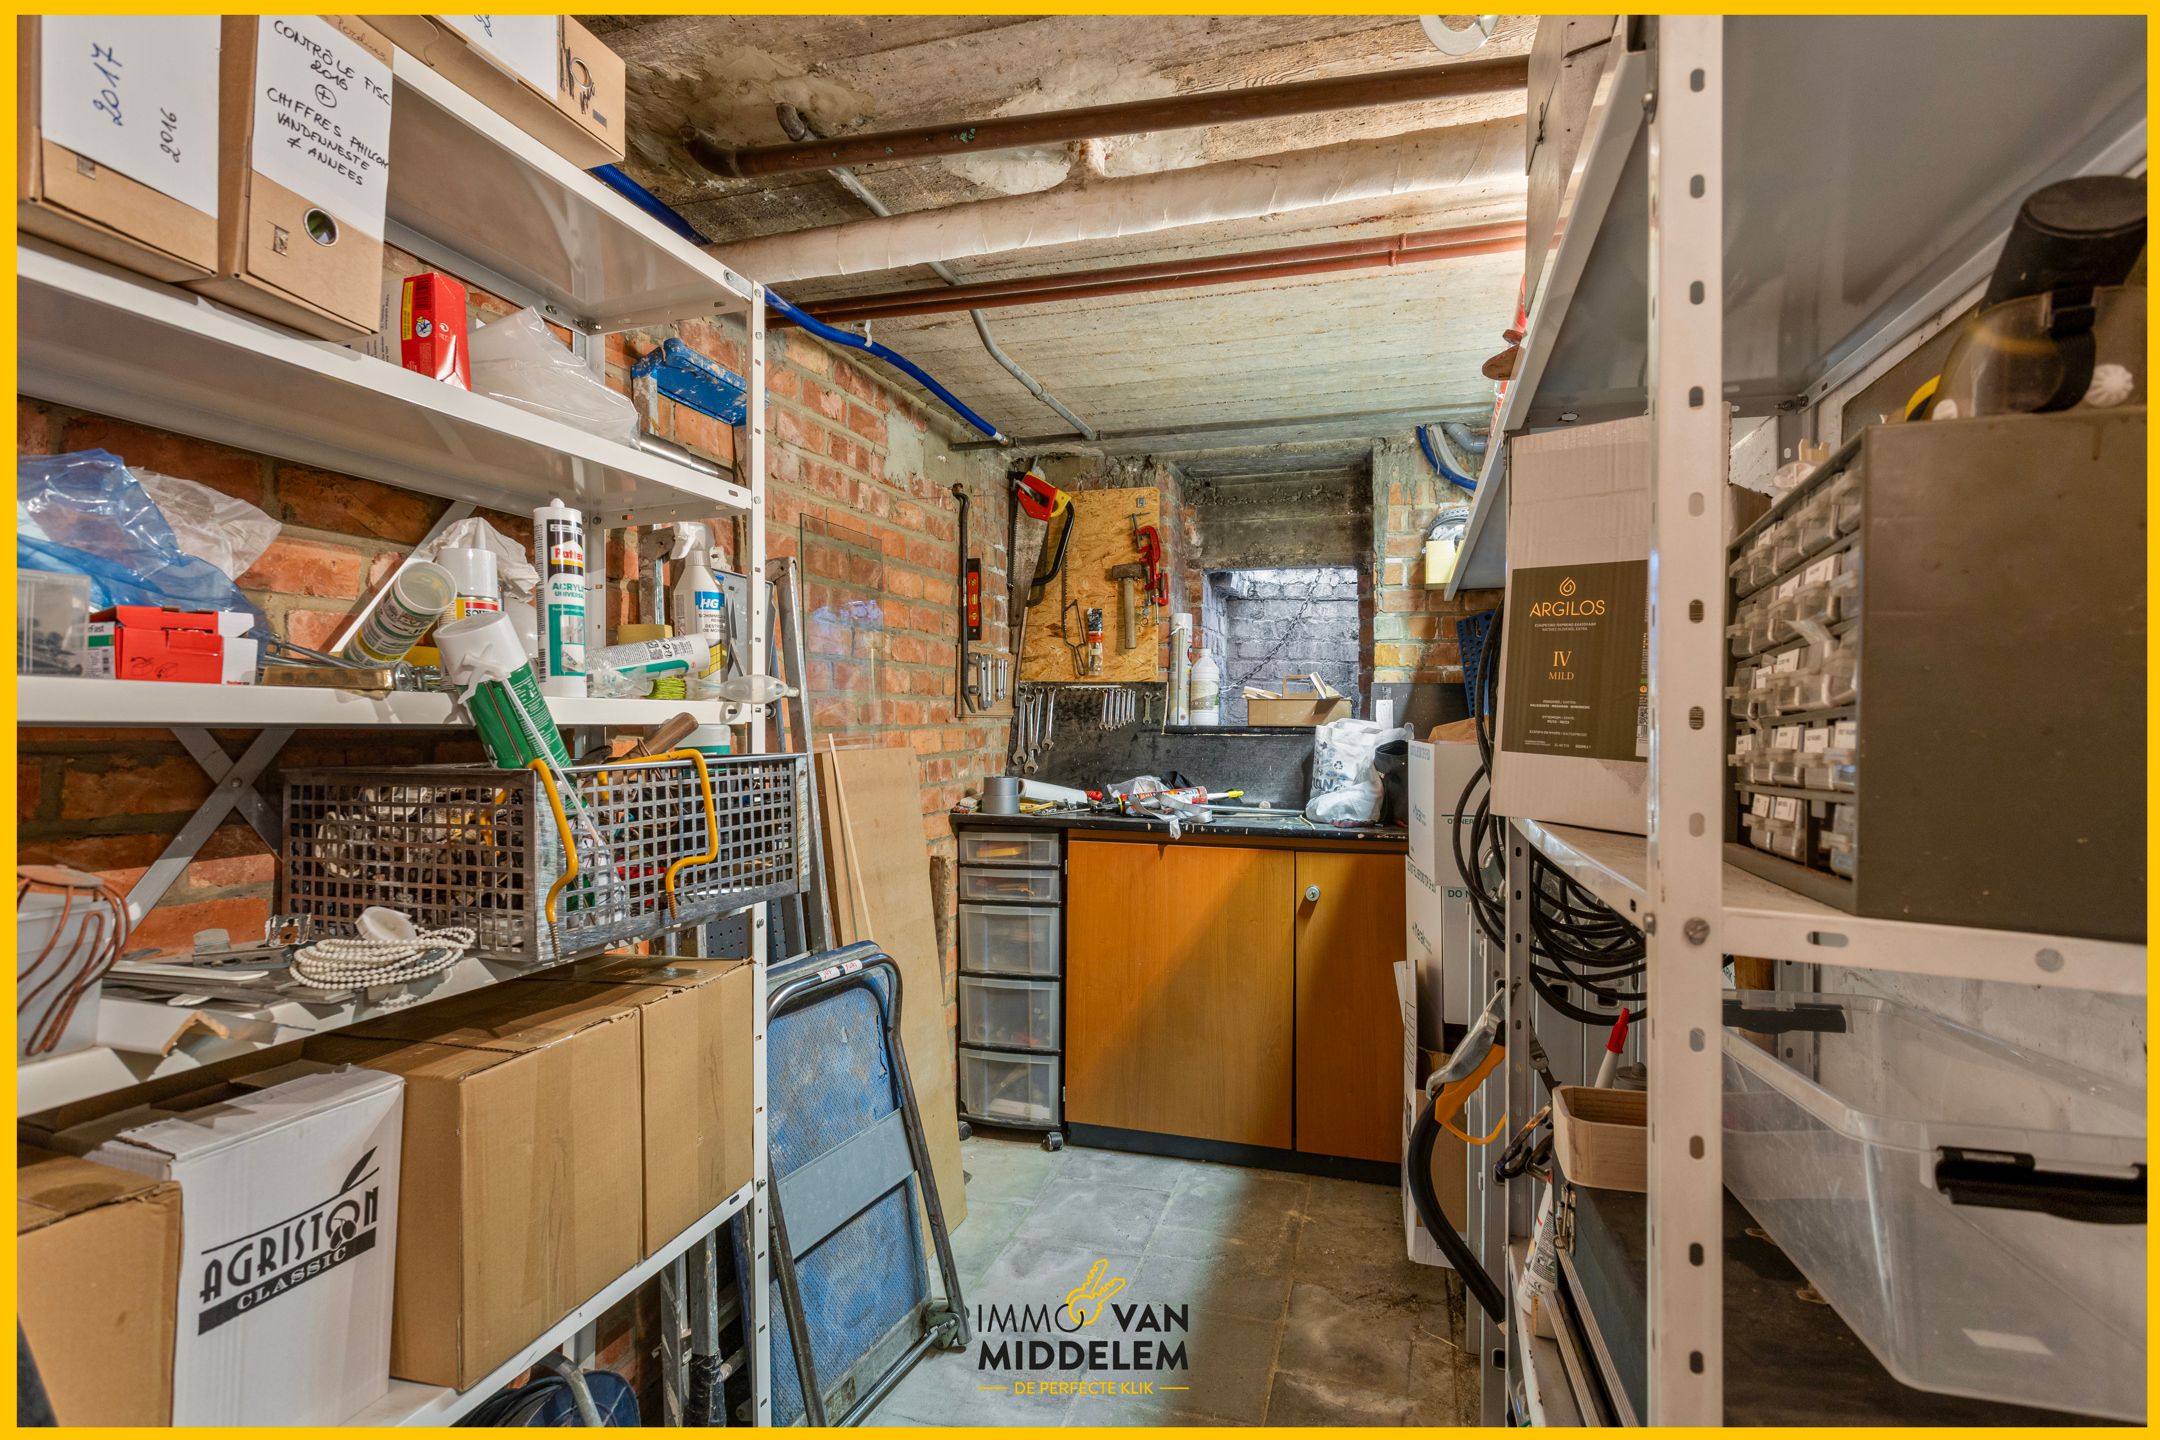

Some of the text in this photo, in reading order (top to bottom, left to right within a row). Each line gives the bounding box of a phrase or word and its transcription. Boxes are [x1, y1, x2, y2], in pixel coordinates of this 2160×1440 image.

[274, 20, 355, 79] CONTRÔLE
[91, 43, 123, 127] 2017
[267, 87, 342, 138] CHIFFRES
[160, 107, 181, 164] 2016
[308, 148, 363, 186] ANNEES
[700, 598, 719, 609] HG
[1529, 600, 1605, 616] ARGILOS
[1548, 671, 1575, 681] MILD
[1553, 650, 1572, 666] IV
[1448, 890, 1462, 898] DO
[200, 1186, 379, 1304] AGRISTON
[237, 1247, 347, 1310] CLASSIC
